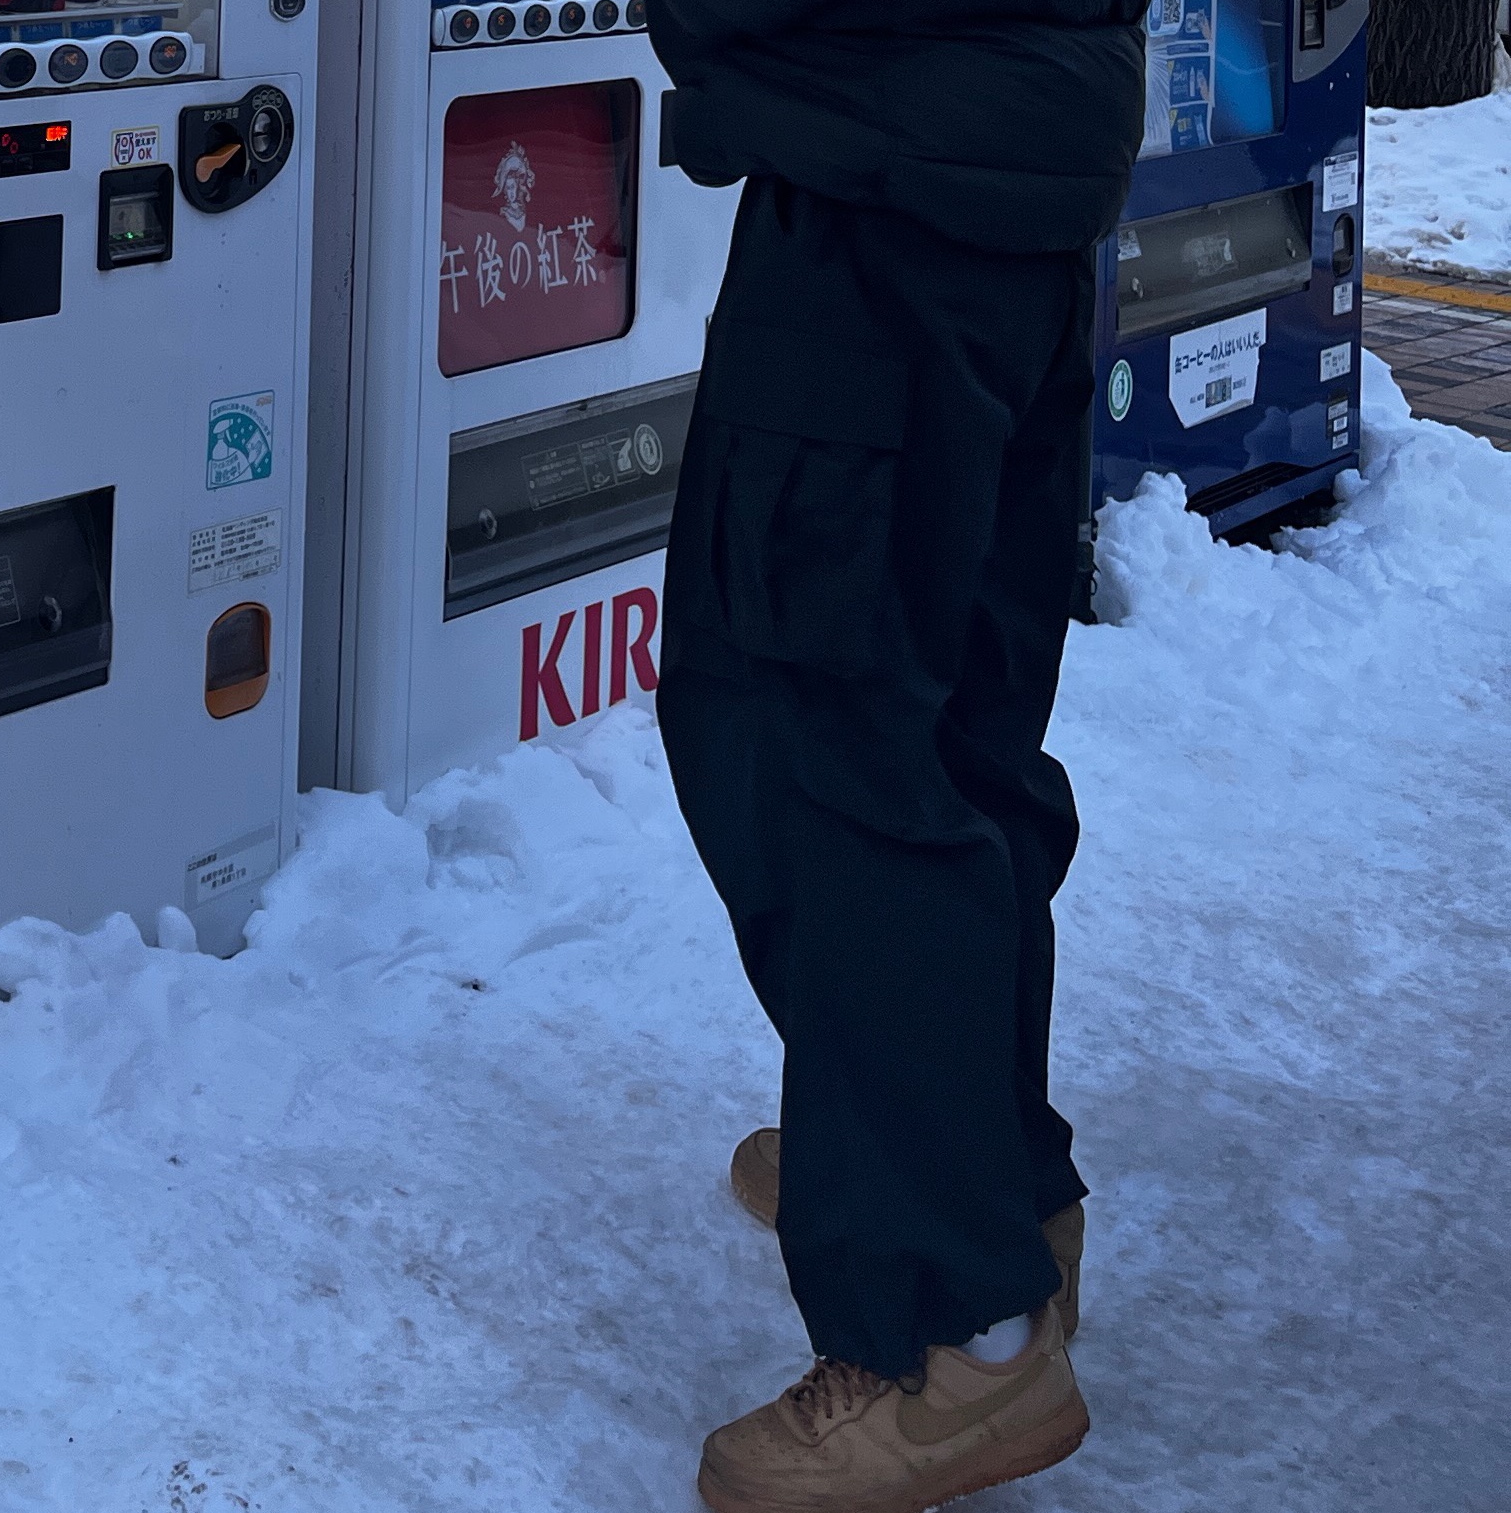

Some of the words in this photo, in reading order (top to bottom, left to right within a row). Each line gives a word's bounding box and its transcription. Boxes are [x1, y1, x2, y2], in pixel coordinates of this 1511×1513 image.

[137, 147, 152, 160] OK
[438, 215, 598, 315] 午後の紅茶
